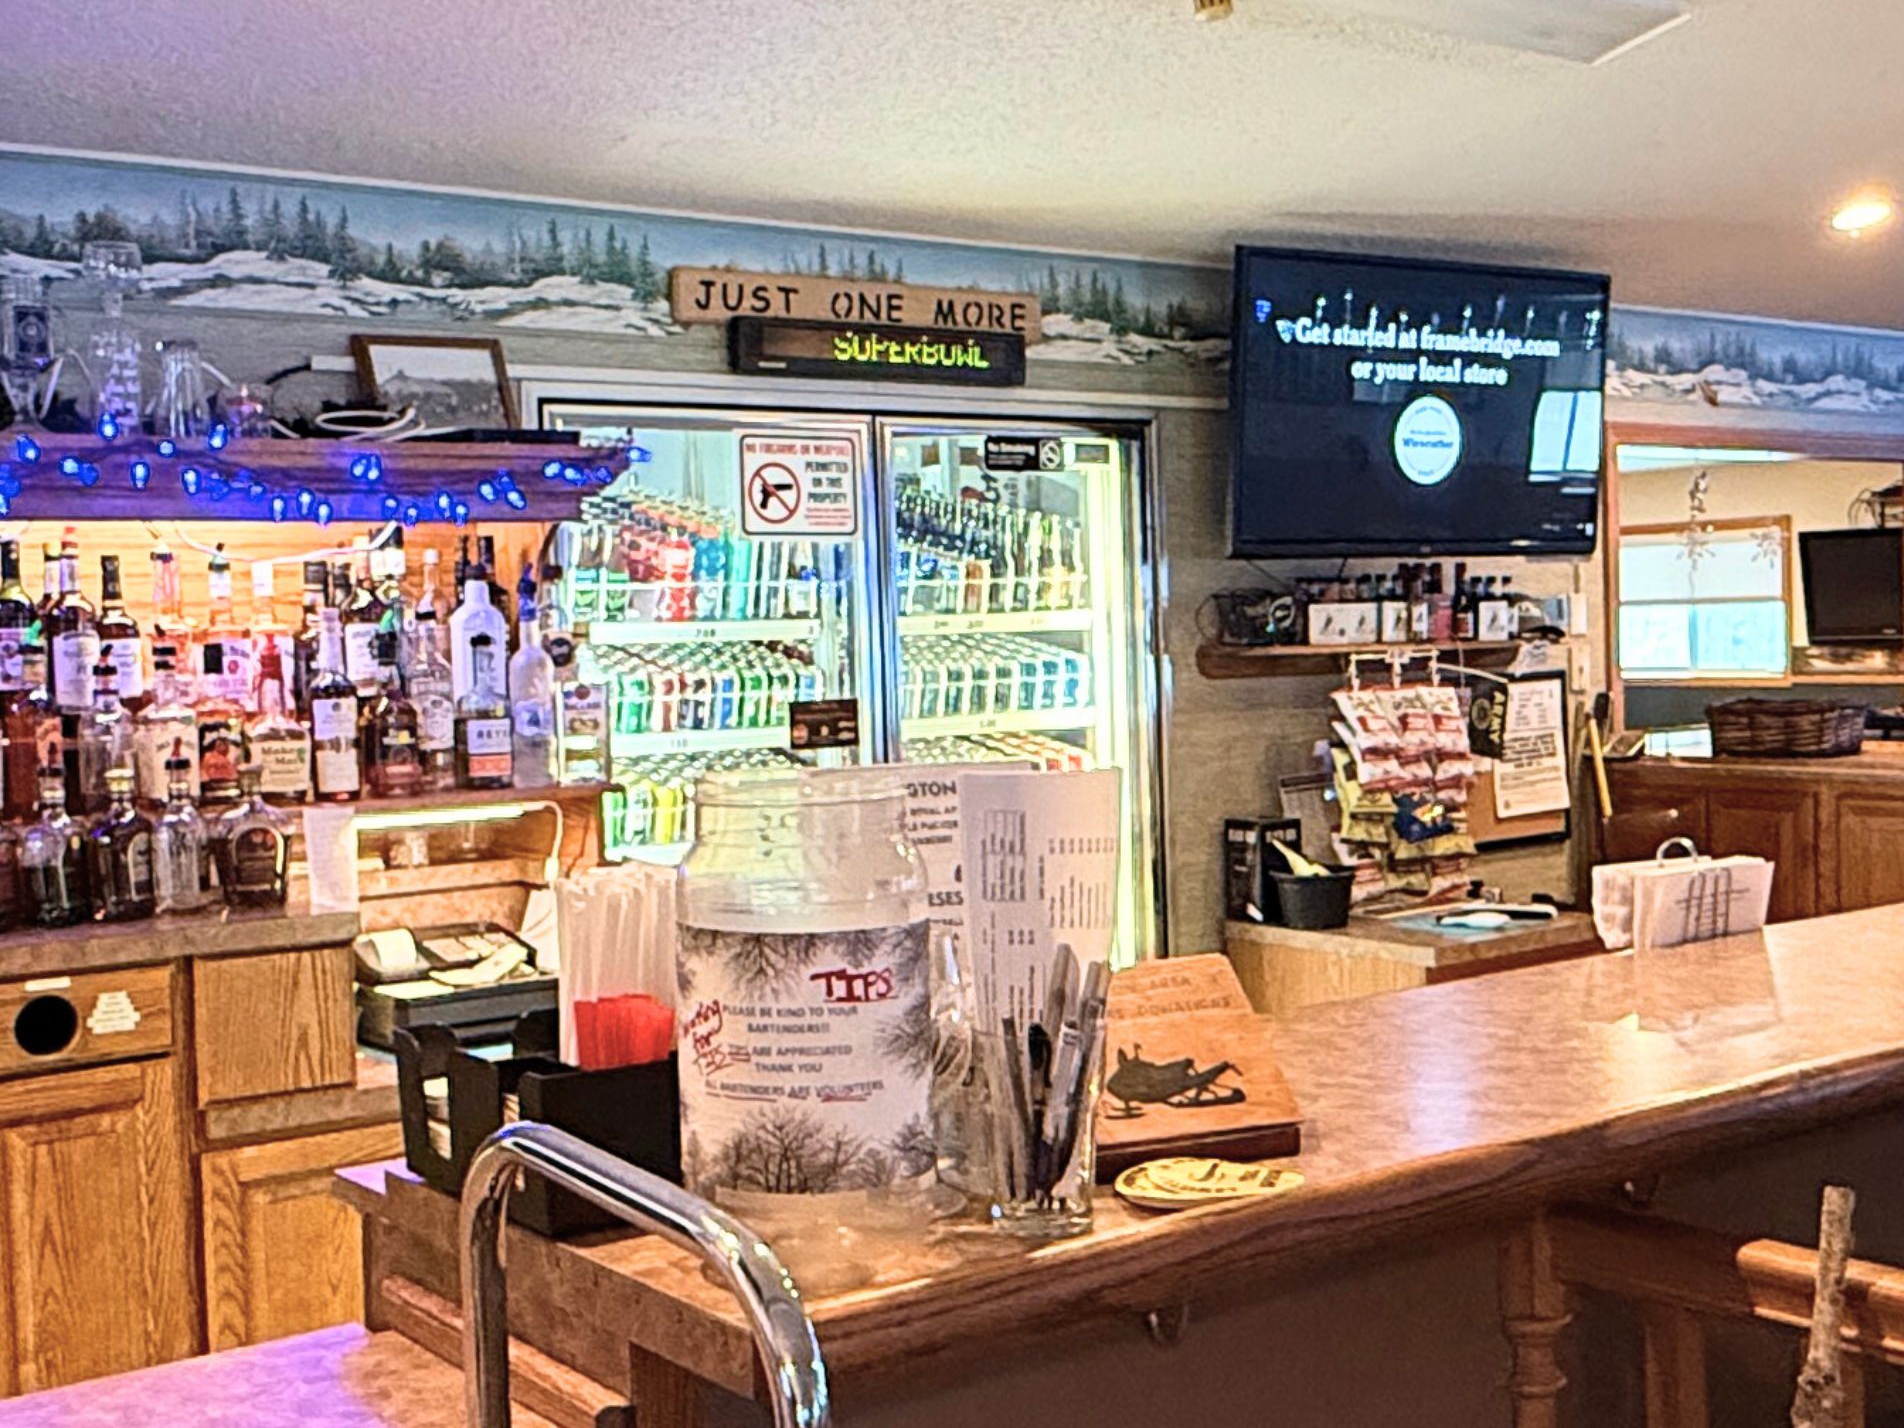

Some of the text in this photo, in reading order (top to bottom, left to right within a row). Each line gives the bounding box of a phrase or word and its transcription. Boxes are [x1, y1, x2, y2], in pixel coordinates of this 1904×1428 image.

[696, 279, 1027, 331] JUST ONE MORE
[1296, 316, 1560, 359] Get started at framebridge.com
[1351, 356, 1508, 385] or your local store
[1488, 689, 1507, 744] ARMY
[809, 967, 896, 1002] TIPS
[776, 1005, 805, 1017] KIND
[808, 1005, 824, 1016] TO
